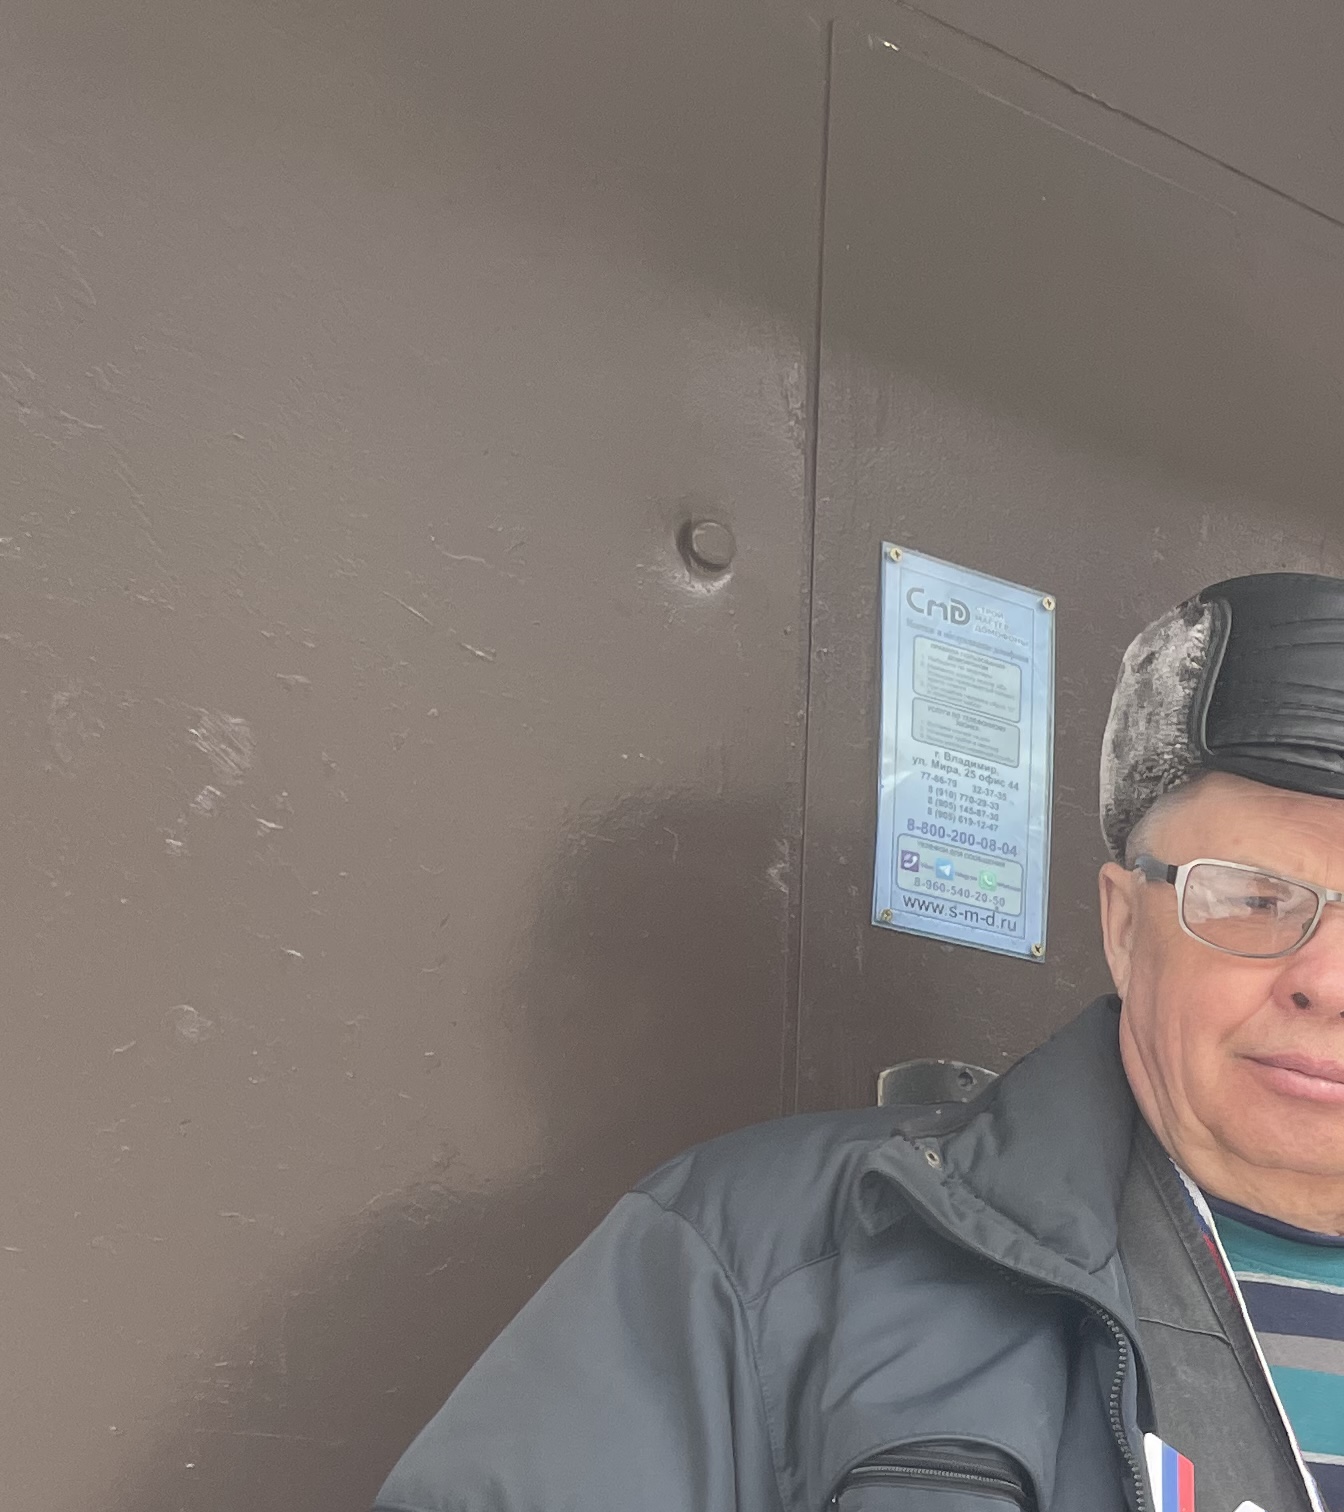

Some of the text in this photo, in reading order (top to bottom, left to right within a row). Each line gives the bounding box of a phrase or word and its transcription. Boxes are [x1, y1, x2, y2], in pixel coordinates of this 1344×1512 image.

[1007, 780, 1019, 791] 44
[907, 818, 1018, 857] 8-800-200-08-04
[913, 876, 1006, 908] 8-960-540-20-50
[902, 894, 1017, 932] www.s-m-d.ru
